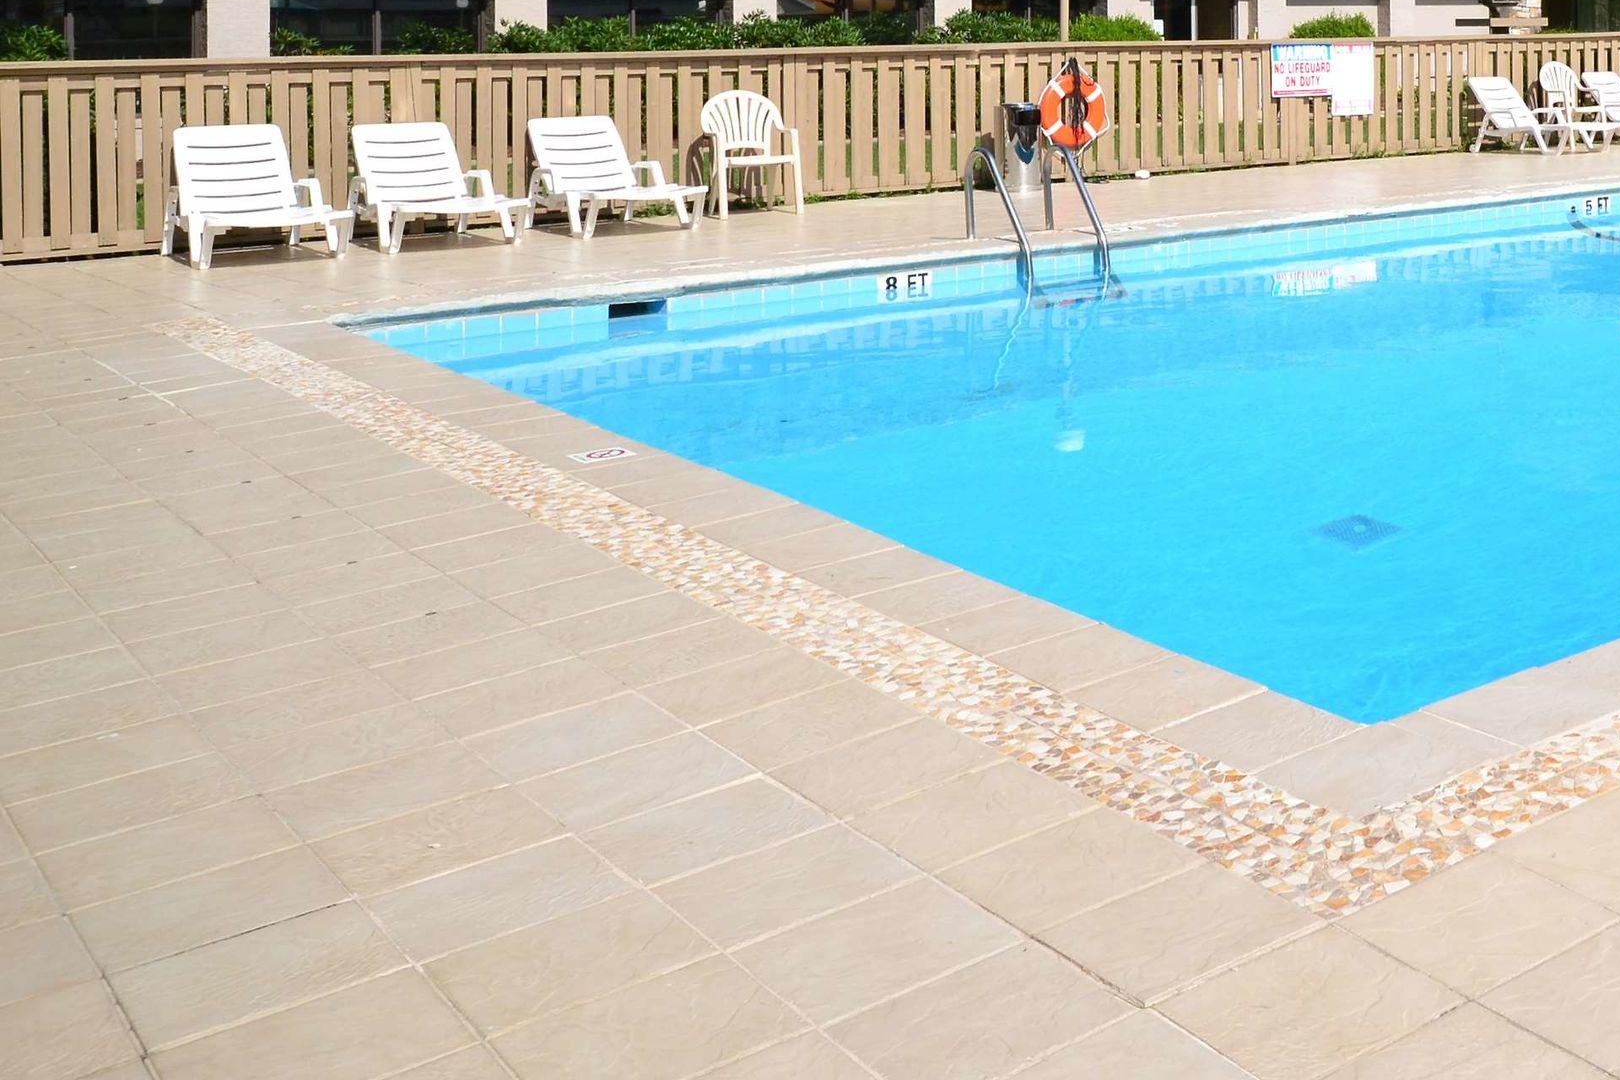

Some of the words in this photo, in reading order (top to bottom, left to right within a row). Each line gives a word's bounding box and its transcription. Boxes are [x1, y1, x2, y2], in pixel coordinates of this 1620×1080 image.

[1274, 62, 1285, 74] NO
[1288, 62, 1331, 74] LIFEGUARD
[1285, 76, 1296, 87] ON
[1299, 76, 1320, 87] DUTY
[1585, 200, 1592, 213] 5
[1597, 196, 1609, 212] FT
[885, 276, 898, 295] 8
